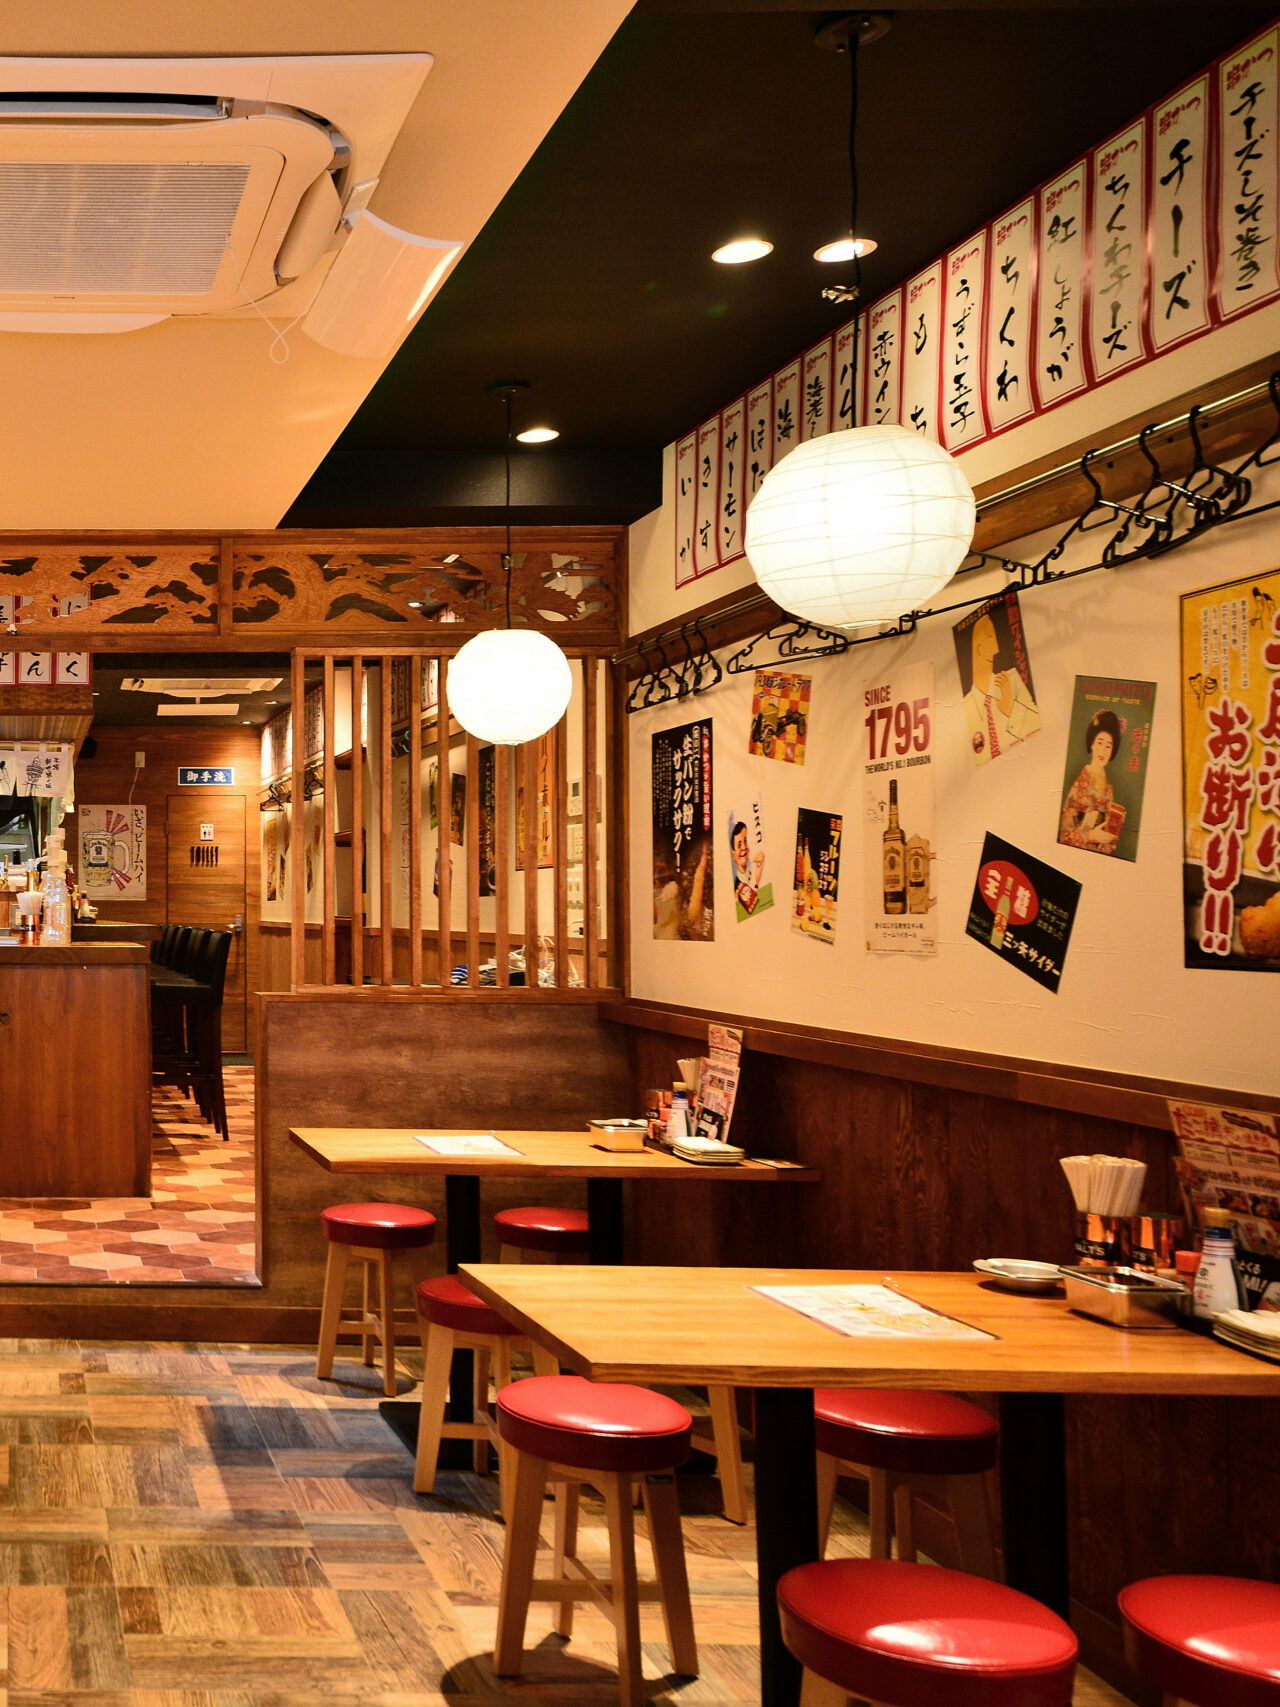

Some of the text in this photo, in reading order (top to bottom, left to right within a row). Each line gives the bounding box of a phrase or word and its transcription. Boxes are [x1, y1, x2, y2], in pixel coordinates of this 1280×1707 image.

[1099, 174, 1132, 359] ちくわチーズ
[1160, 138, 1197, 320] チーズ
[996, 255, 1020, 402] ちくわ
[1046, 215, 1077, 383] 紅しょうが
[872, 330, 896, 426] 赤ウイン
[910, 314, 928, 437] もち
[949, 279, 975, 433] うずら玉子
[750, 418, 766, 493] ほた
[777, 398, 795, 444] 海
[724, 431, 739, 549] サーモン
[864, 684, 891, 707] SINCE
[864, 697, 931, 760] 1795
[186, 770, 227, 783] 御手洗
[682, 733, 694, 840] 生パン粉で
